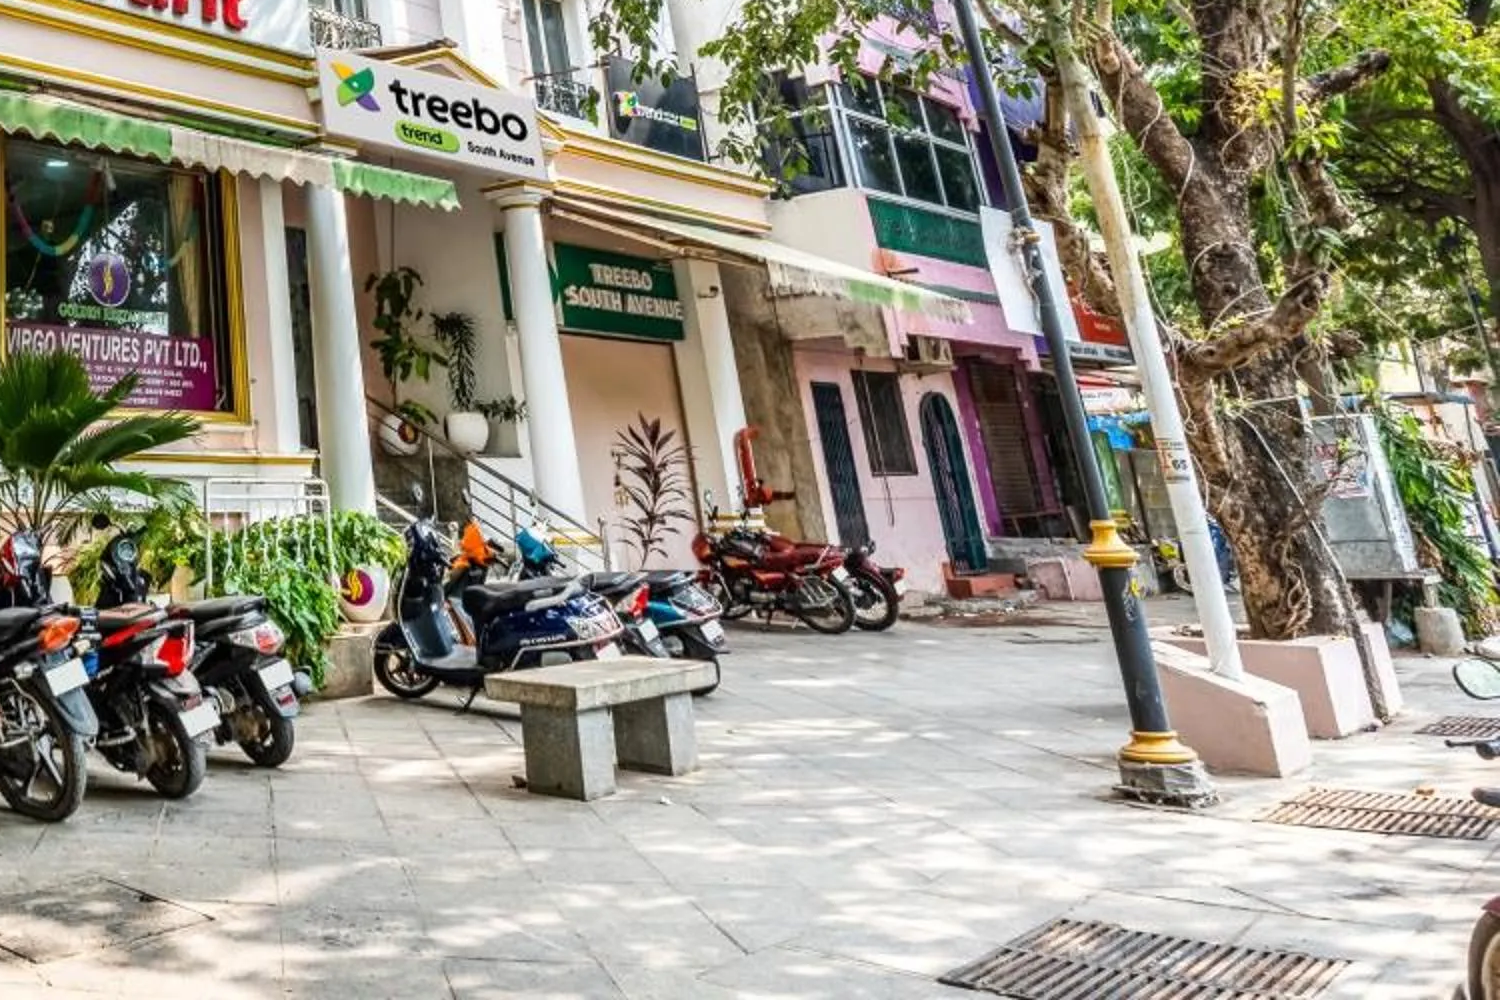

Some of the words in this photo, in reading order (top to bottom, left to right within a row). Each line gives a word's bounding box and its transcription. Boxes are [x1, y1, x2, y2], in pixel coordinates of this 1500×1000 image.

[388, 79, 528, 142] treebo
[401, 123, 443, 145] trend
[467, 141, 497, 158] South
[499, 148, 535, 167] Avenue
[588, 263, 653, 291] TREEBO
[564, 285, 622, 312] SOUTH
[626, 294, 685, 321] AVENUE
[7, 327, 57, 356] VIRGO
[61, 332, 141, 363] VENTURES
[143, 338, 171, 365] PVT
